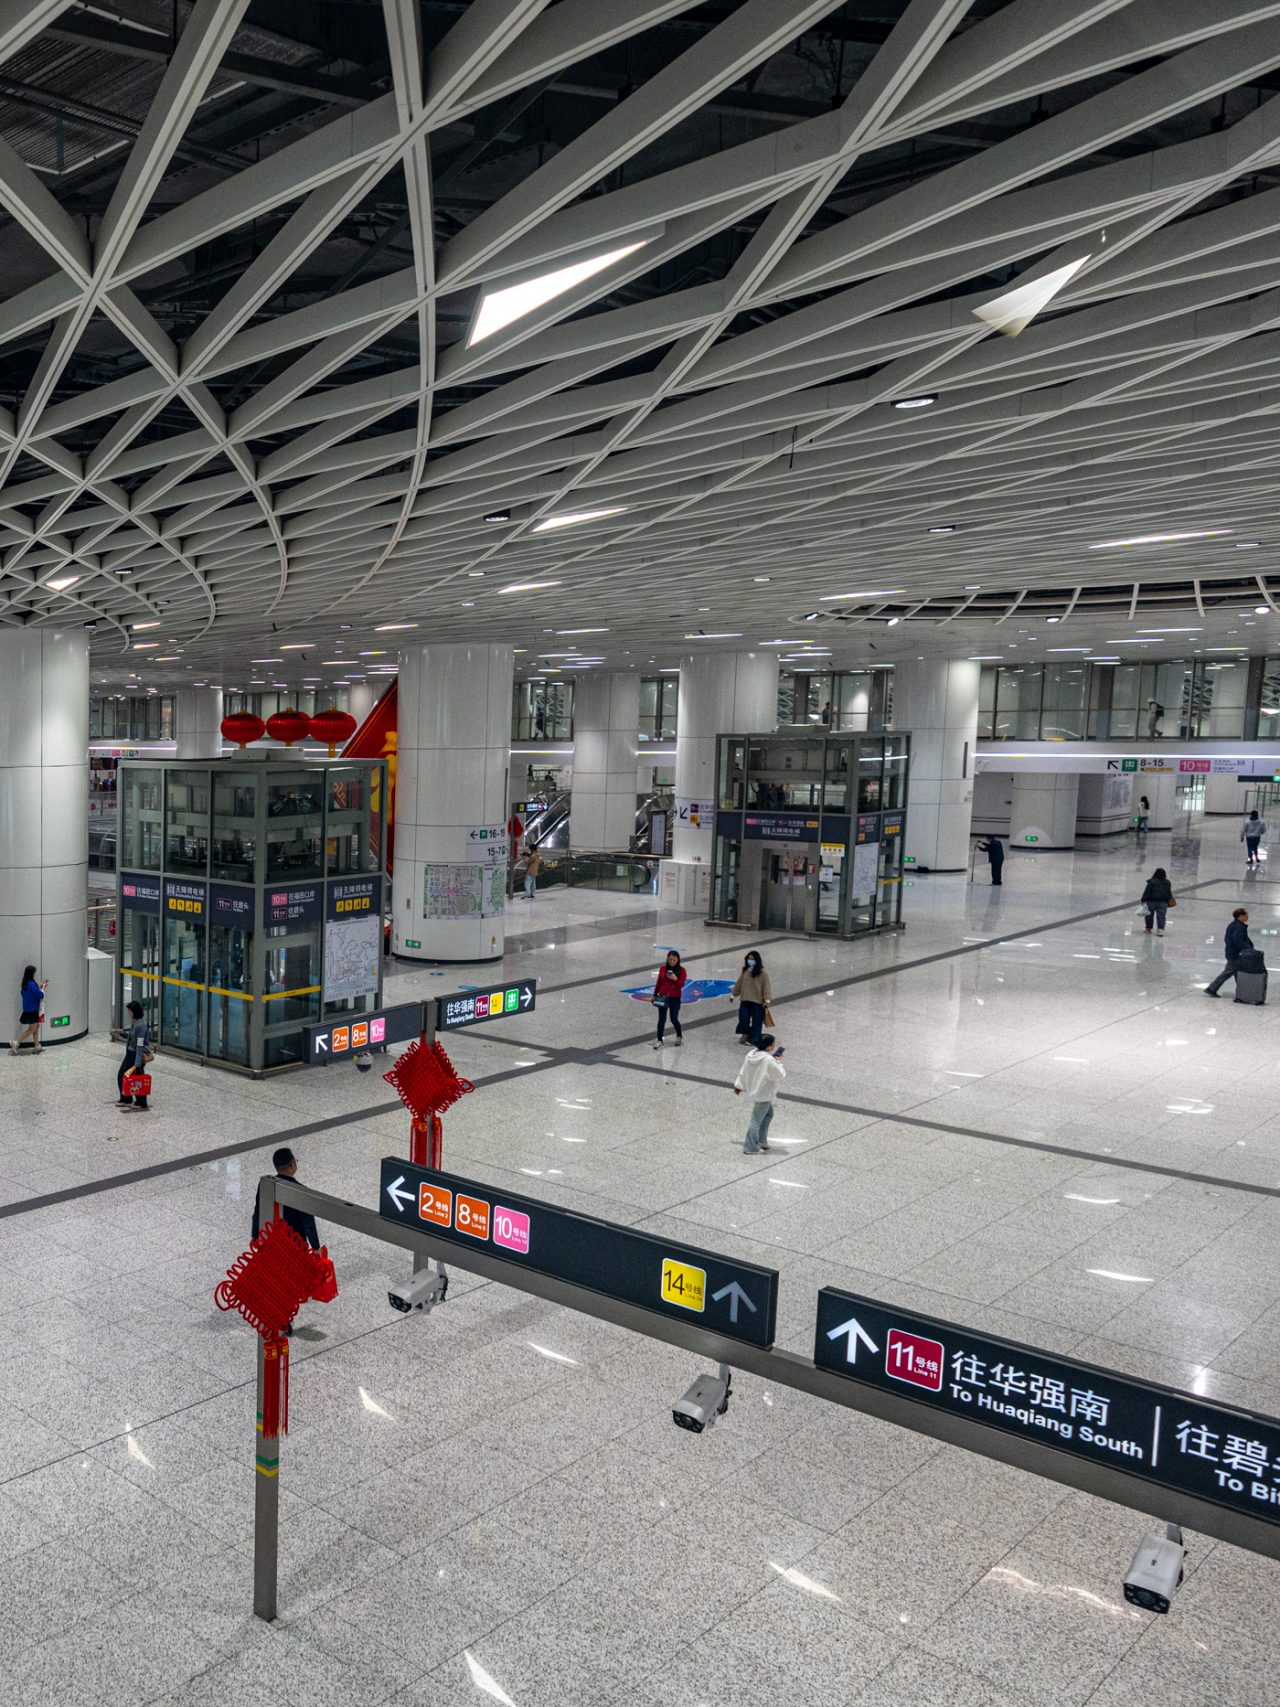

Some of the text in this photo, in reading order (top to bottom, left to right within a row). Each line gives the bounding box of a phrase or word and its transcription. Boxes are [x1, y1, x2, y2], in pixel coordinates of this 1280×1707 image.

[446, 998, 474, 1017] 往华强南
[422, 1192, 449, 1214] 2号线
[458, 1204, 486, 1225] 8号线
[496, 1215, 527, 1239] 10号线
[664, 1270, 703, 1296] 14号线
[890, 1341, 938, 1372] 11号线
[912, 1365, 928, 1378] Line
[950, 1349, 1111, 1426] 往华强南
[950, 1383, 1144, 1460] To Huaqiang South
[1214, 1469, 1244, 1492] To
